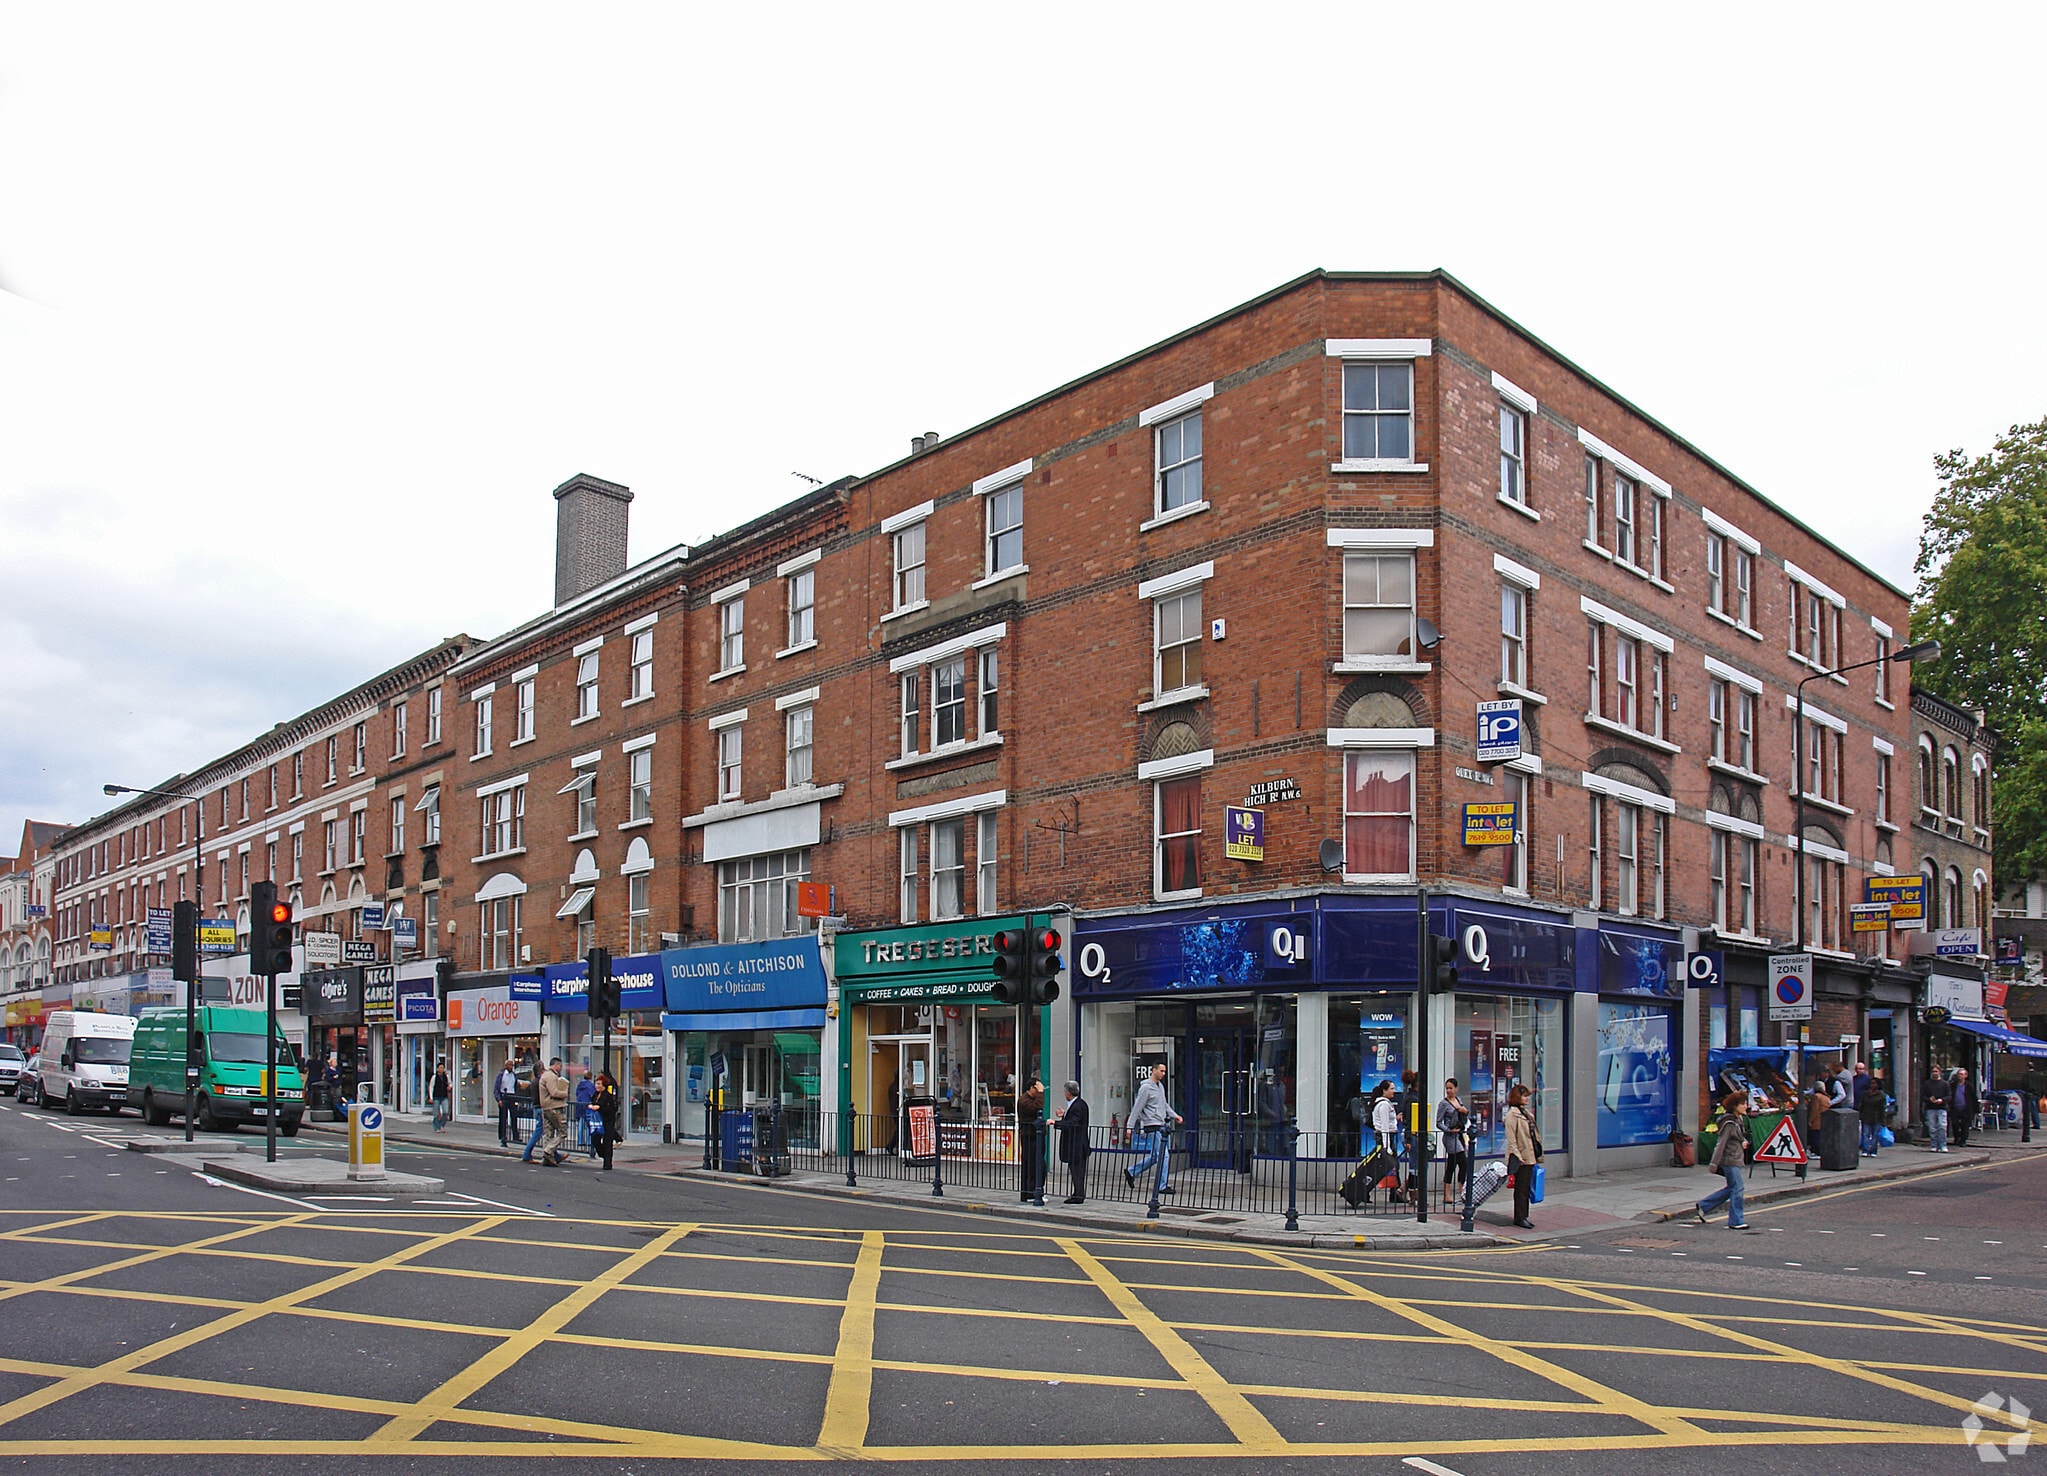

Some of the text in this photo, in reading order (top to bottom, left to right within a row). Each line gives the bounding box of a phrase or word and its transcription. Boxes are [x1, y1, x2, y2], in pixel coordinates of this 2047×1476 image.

[1481, 701, 1514, 711] LET BY
[1250, 777, 1295, 796] KILBURN
[1244, 794, 1266, 807] HIGH
[1477, 805, 1504, 813] TO LET
[1238, 834, 1255, 846] LET
[159, 909, 171, 917] LET
[1893, 907, 1918, 915] 9500
[319, 937, 339, 945] SPICER
[347, 943, 371, 951] MEGA
[1272, 927, 1295, 964] O2
[1464, 924, 1490, 972] O2
[307, 951, 339, 959] SOLICITORS
[861, 934, 993, 963] TREGESER
[1941, 945, 1974, 954] OPEN
[671, 954, 805, 979] DOLLOND & AITCHISON
[1080, 942, 1111, 983] O2
[1771, 957, 1810, 965] Controlled
[366, 968, 392, 985] MEGA
[1690, 955, 1718, 984] O2
[1776, 965, 1804, 974] ZONE
[365, 985, 393, 1001] GAMES
[556, 976, 590, 996] Carpho
[708, 979, 766, 997] The Opticians
[867, 981, 1001, 999] COFFEE CAKES BREAD DOUGH
[478, 997, 519, 1026] Orange
[1371, 1013, 1393, 1021] WOW
[1499, 1047, 1519, 1062] FREE
[1136, 1065, 1152, 1079] FRE
